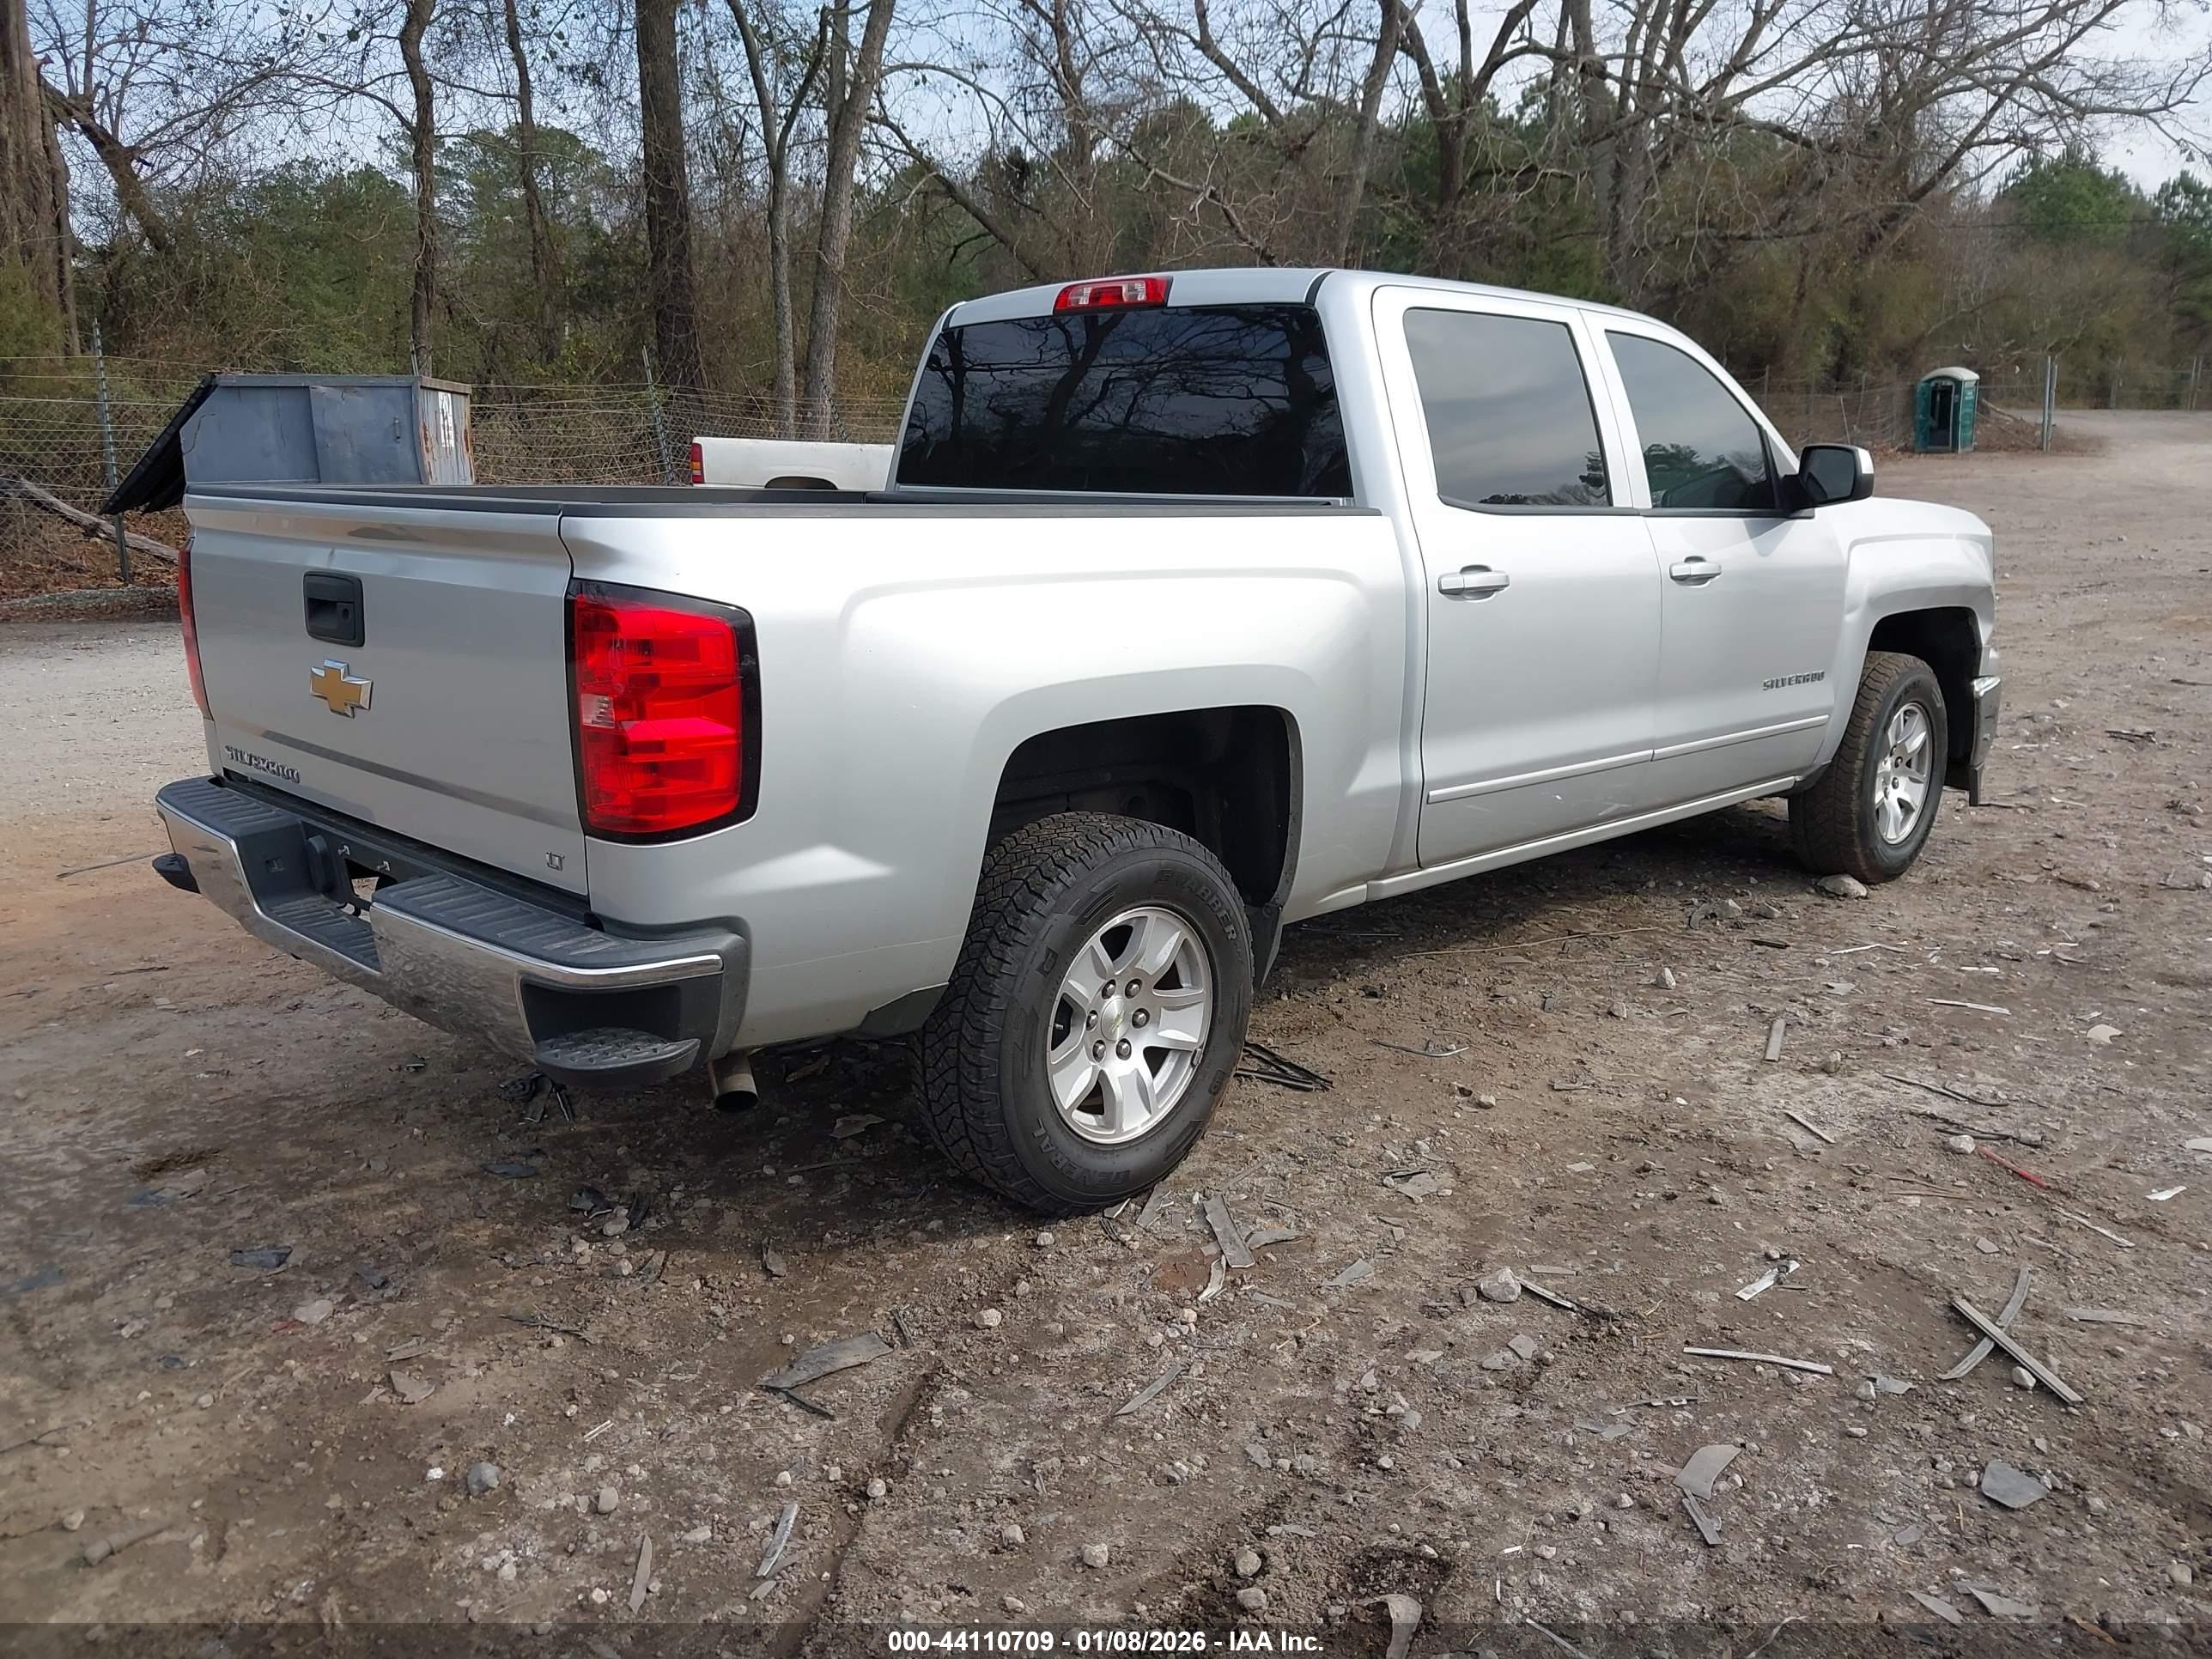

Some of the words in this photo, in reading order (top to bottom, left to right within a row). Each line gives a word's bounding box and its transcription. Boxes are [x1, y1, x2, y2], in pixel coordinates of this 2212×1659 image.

[1762, 669, 1826, 691] SILVERADO
[224, 744, 301, 783] SILVERADO
[545, 851, 565, 872] LT
